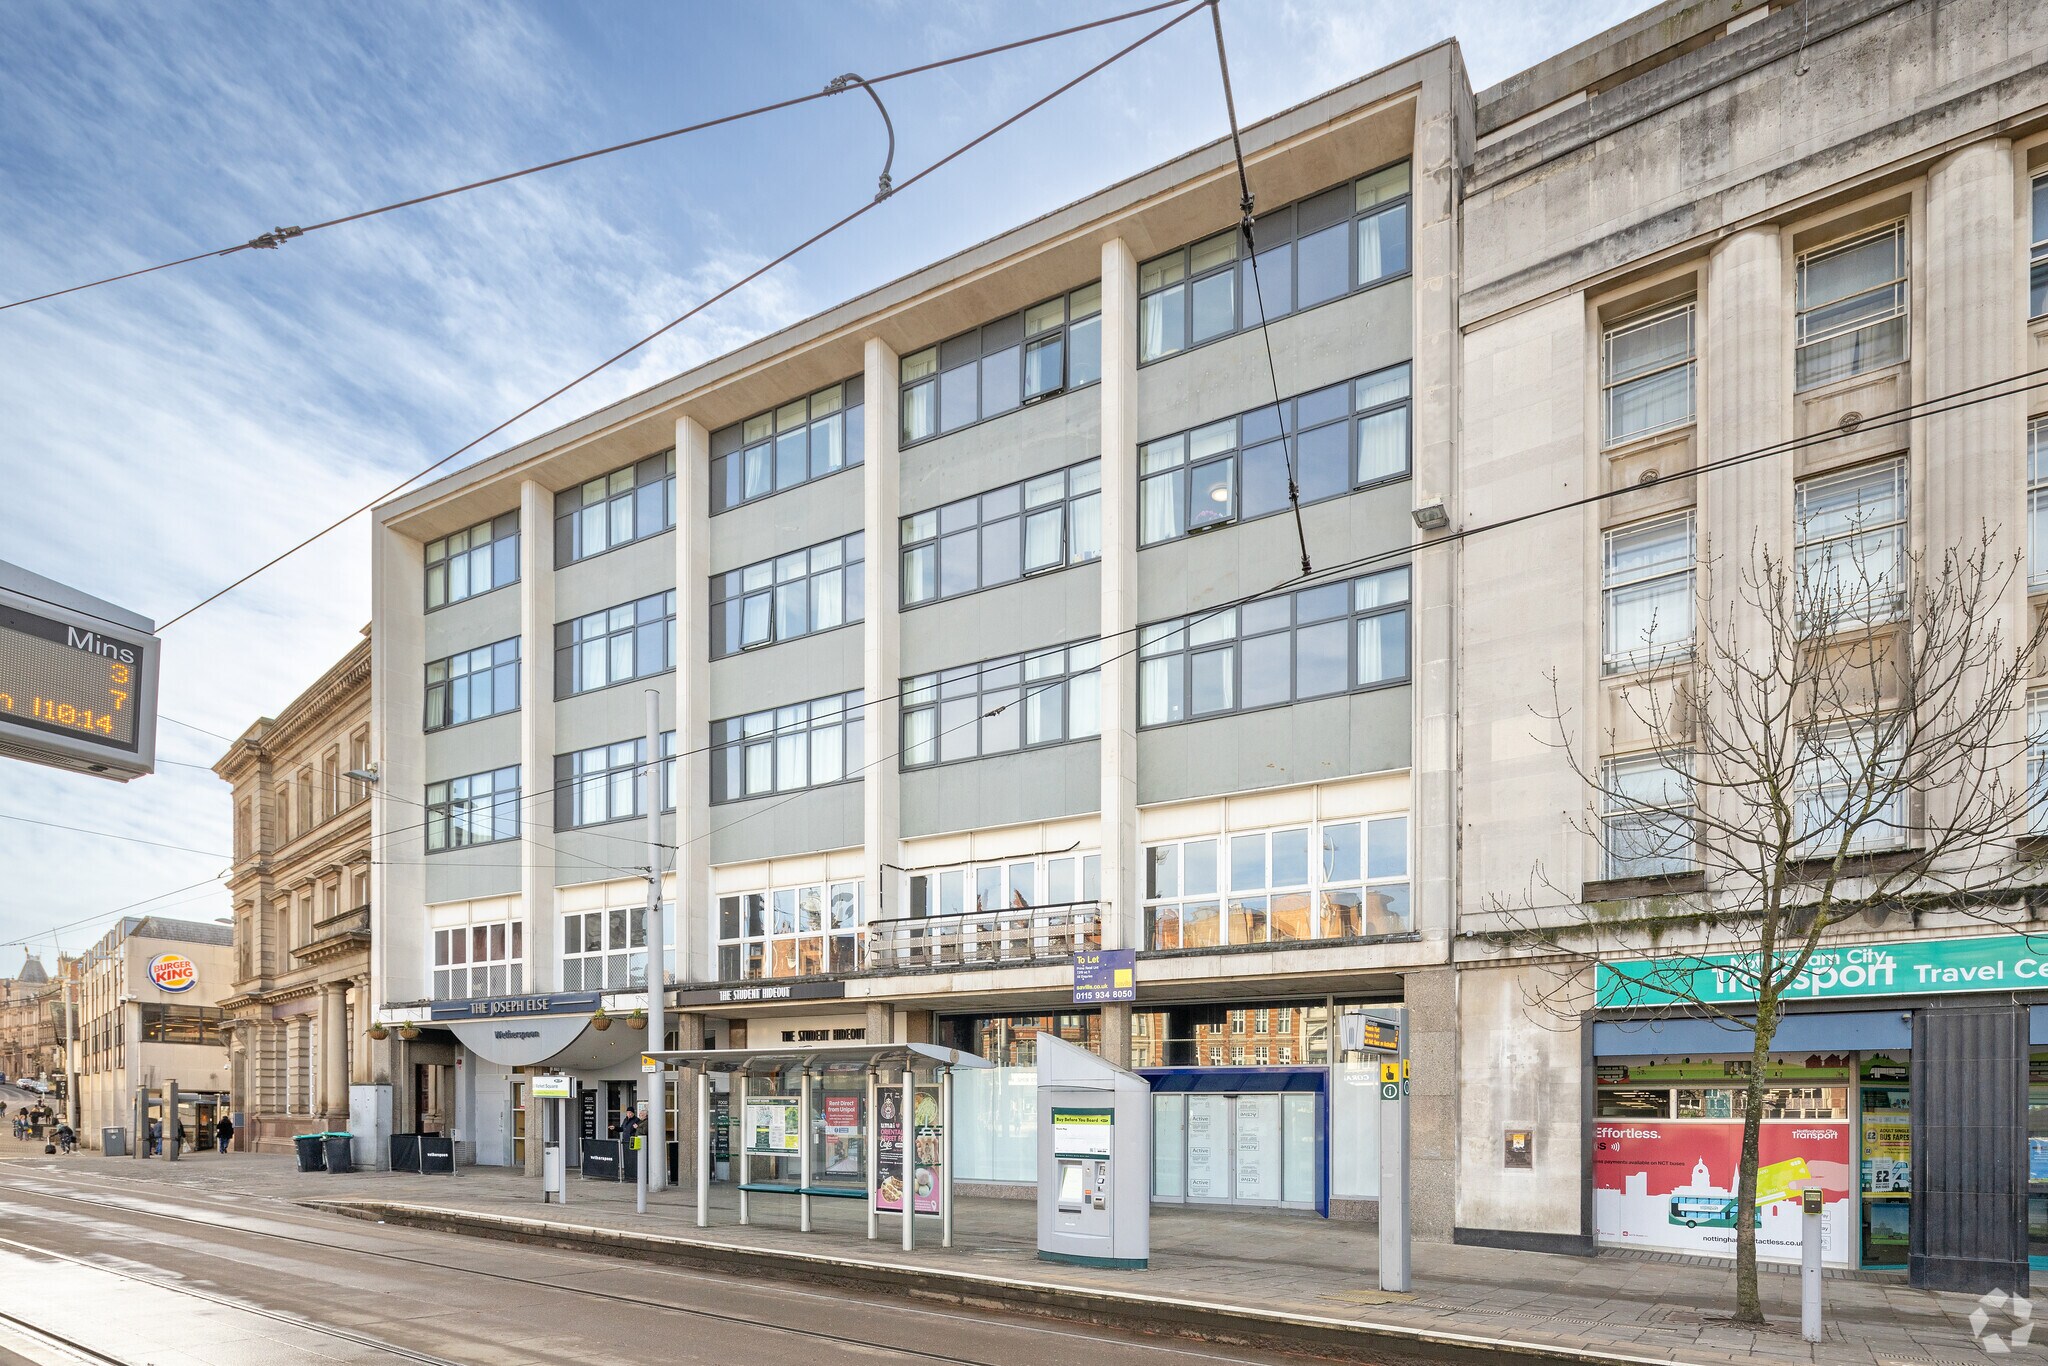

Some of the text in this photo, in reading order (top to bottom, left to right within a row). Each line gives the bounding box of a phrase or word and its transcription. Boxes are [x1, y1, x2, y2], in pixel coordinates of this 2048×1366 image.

[67, 626, 134, 664] Mins
[111, 664, 129, 683] 3
[109, 689, 127, 710] 7
[1077, 956, 1099, 964] To Let
[1847, 949, 1886, 967] City
[153, 961, 191, 973] BURGER
[1913, 960, 2002, 983] Travel
[156, 968, 193, 983] KING
[719, 986, 791, 1001] THE STUDENT HIDEOUT
[1076, 990, 1132, 1000] 0115 934 8050
[470, 999, 549, 1016] THE JOSEPH ELSE
[781, 1028, 866, 1042] THE STUDENT HIDEOUT
[1792, 1131, 1838, 1140] Transport
[1876, 1170, 1890, 1182] £2
